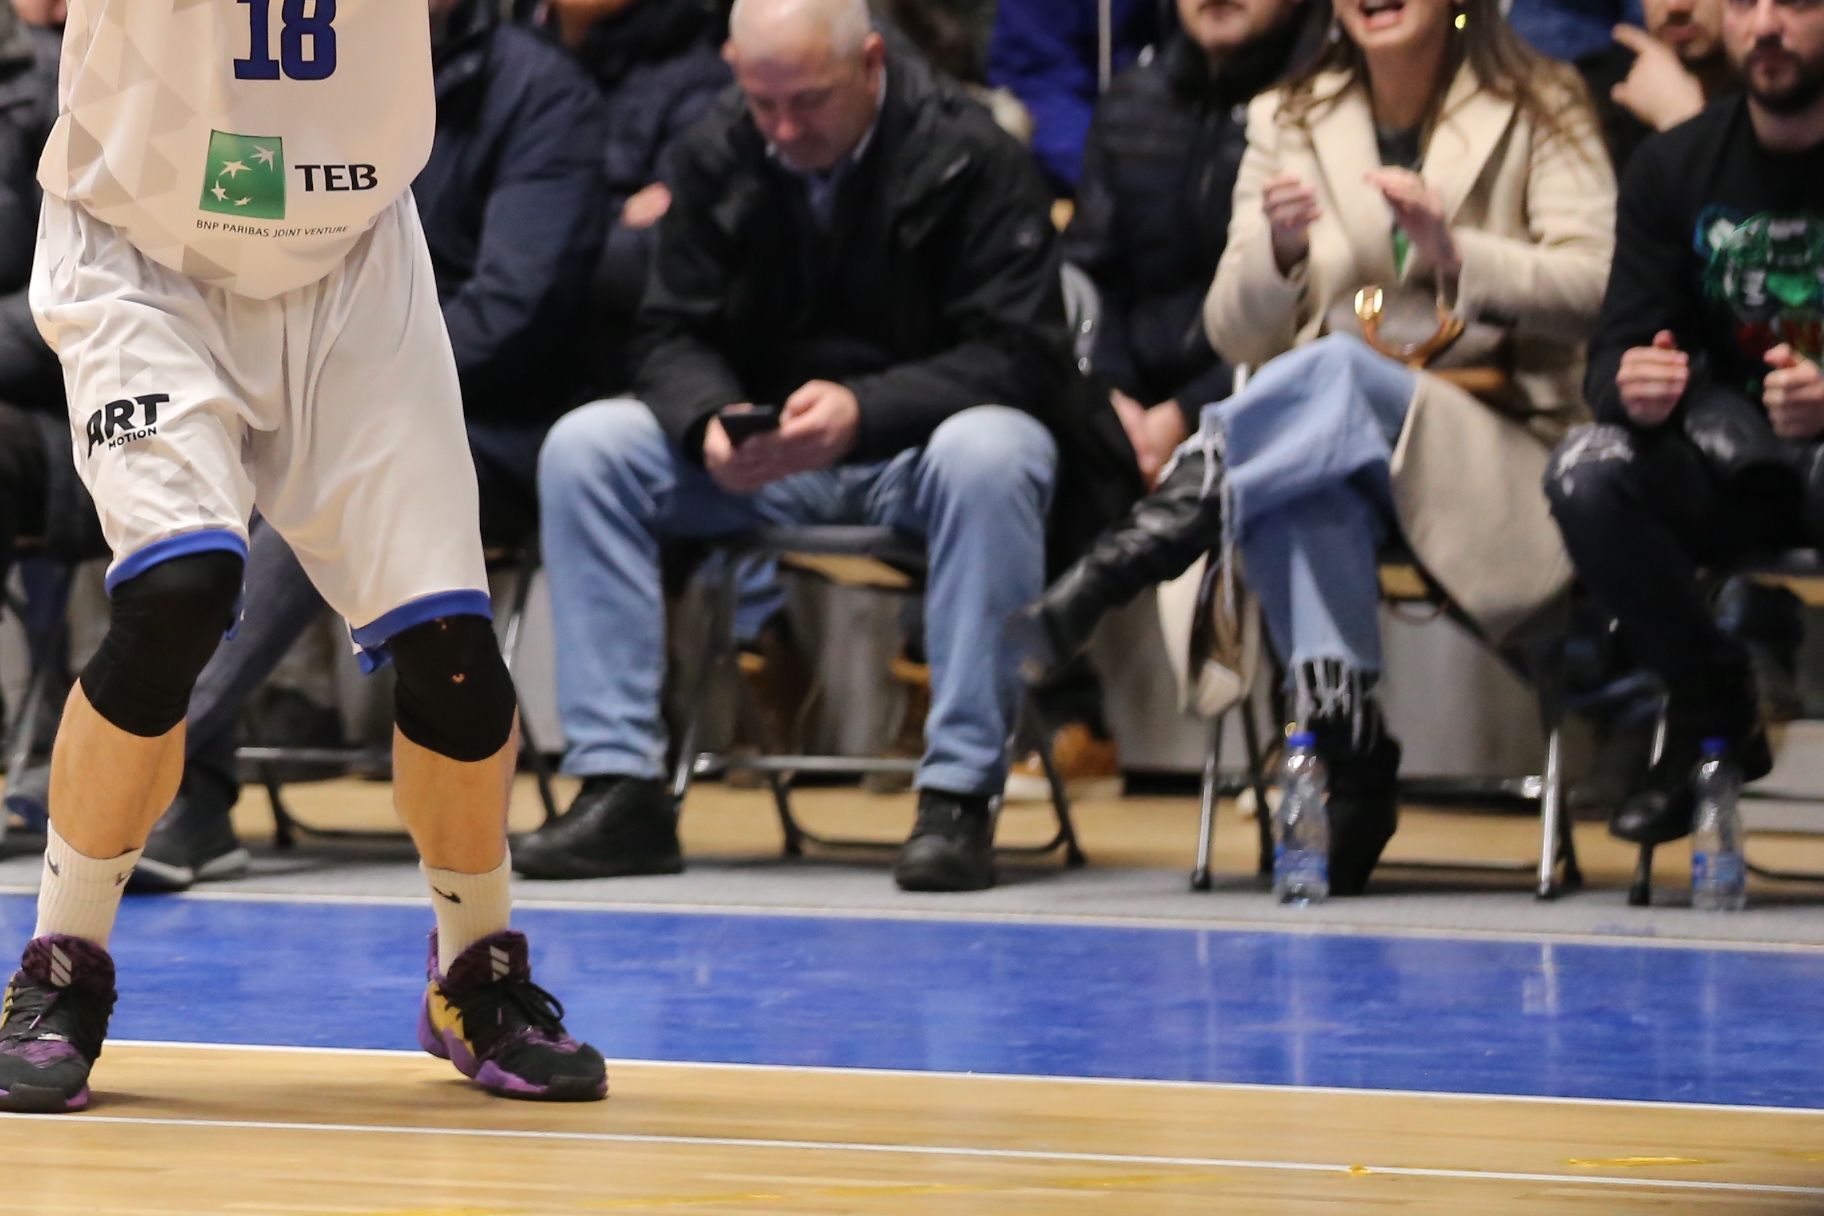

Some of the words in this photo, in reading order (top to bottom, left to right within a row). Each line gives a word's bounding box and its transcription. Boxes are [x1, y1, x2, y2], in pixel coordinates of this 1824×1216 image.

[295, 164, 378, 192] TEB
[196, 219, 219, 231] BNP
[222, 223, 270, 237] PARIBAS
[273, 228, 301, 238] JOINT
[304, 225, 349, 236] VENTURE
[87, 393, 170, 460] ART
[108, 427, 157, 451] MOTION
